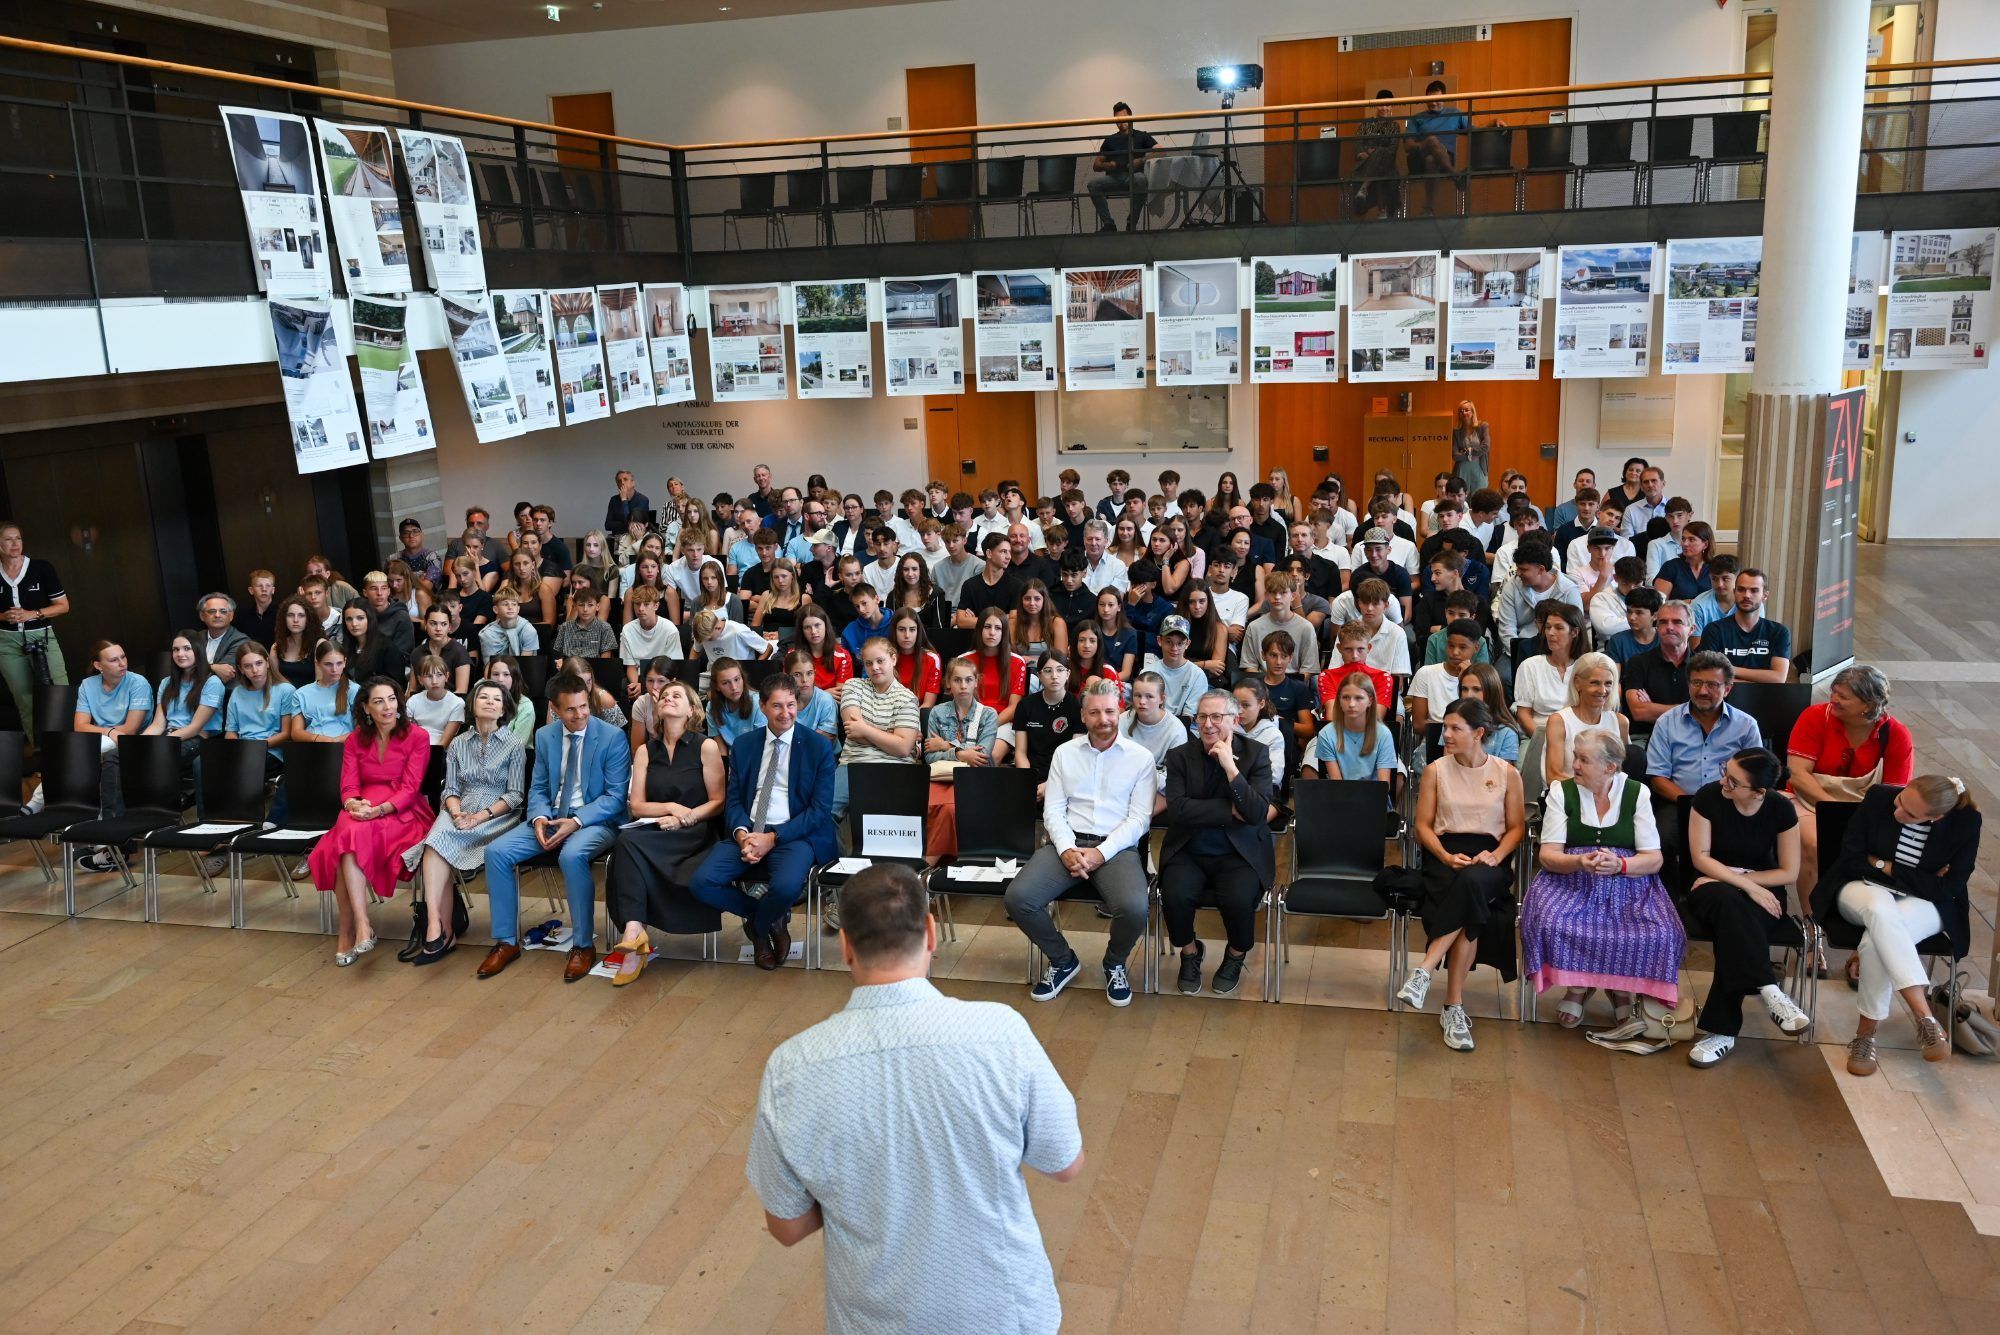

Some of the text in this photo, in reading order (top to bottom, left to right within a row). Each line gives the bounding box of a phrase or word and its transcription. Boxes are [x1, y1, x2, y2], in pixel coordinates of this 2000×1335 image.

[662, 420, 740, 429] LANDTAGSKLUBS DER
[707, 440, 734, 450] GRÜNEN
[1724, 647, 1770, 656] HEAD
[867, 829, 918, 838] RESERVIERT
